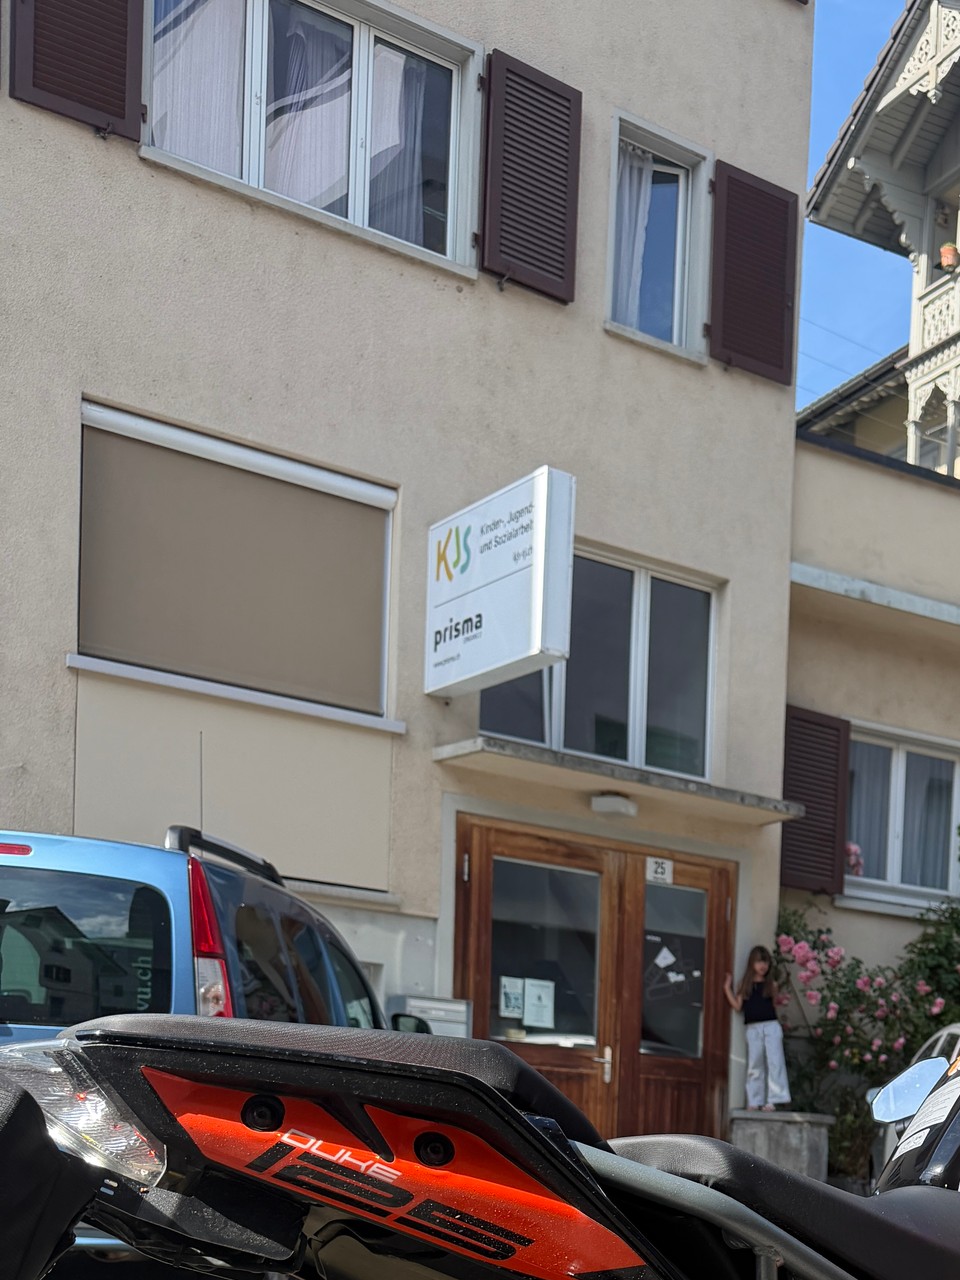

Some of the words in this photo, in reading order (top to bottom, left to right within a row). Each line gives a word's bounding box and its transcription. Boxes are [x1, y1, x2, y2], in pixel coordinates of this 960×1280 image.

[435, 525, 472, 582] KJS
[479, 539, 493, 554] und
[434, 613, 483, 653] prisma
[653, 860, 666, 876] 25
[280, 1128, 403, 1184] DUKE
[244, 1141, 536, 1261] 125
